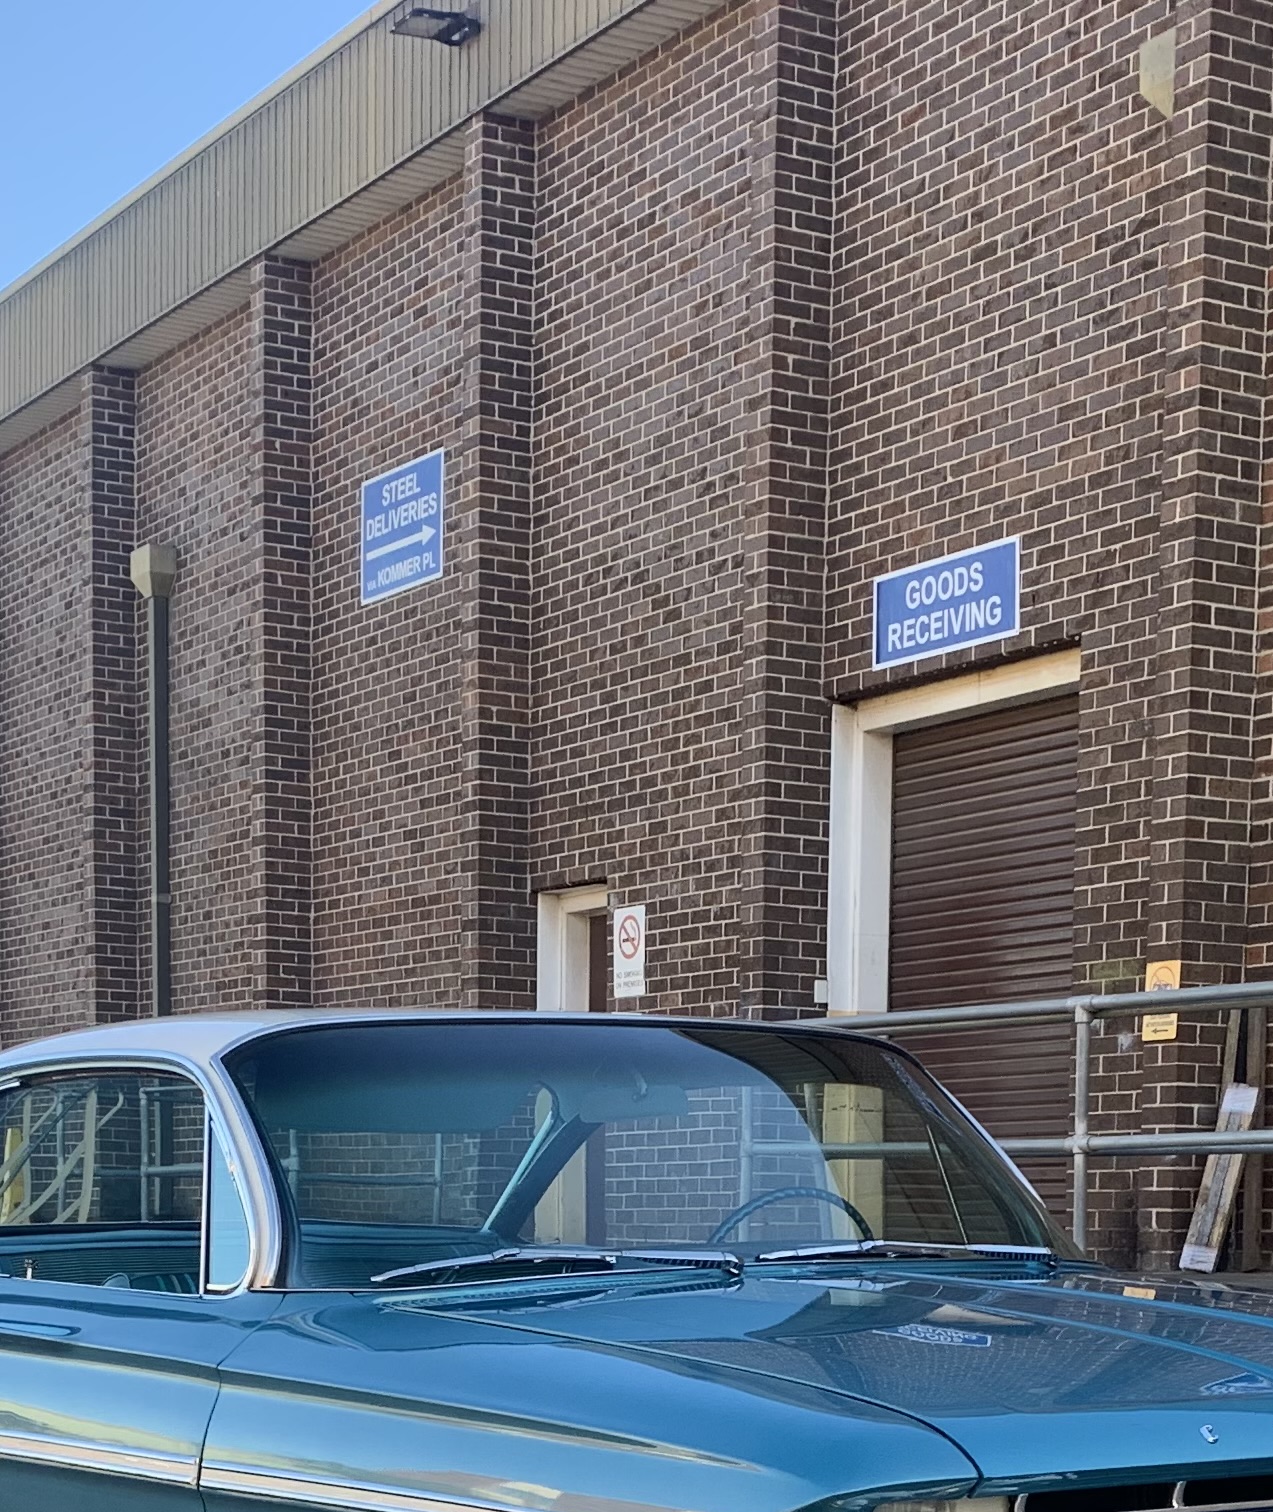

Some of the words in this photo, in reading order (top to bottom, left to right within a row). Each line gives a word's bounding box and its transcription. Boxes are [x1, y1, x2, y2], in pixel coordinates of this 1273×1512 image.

[382, 472, 421, 507] STEEL
[366, 492, 437, 541] DELIVERIES
[377, 555, 421, 588] KOMMER
[422, 551, 436, 571] PL
[905, 561, 984, 609] GOODS
[888, 595, 1002, 652] RECEIVING
